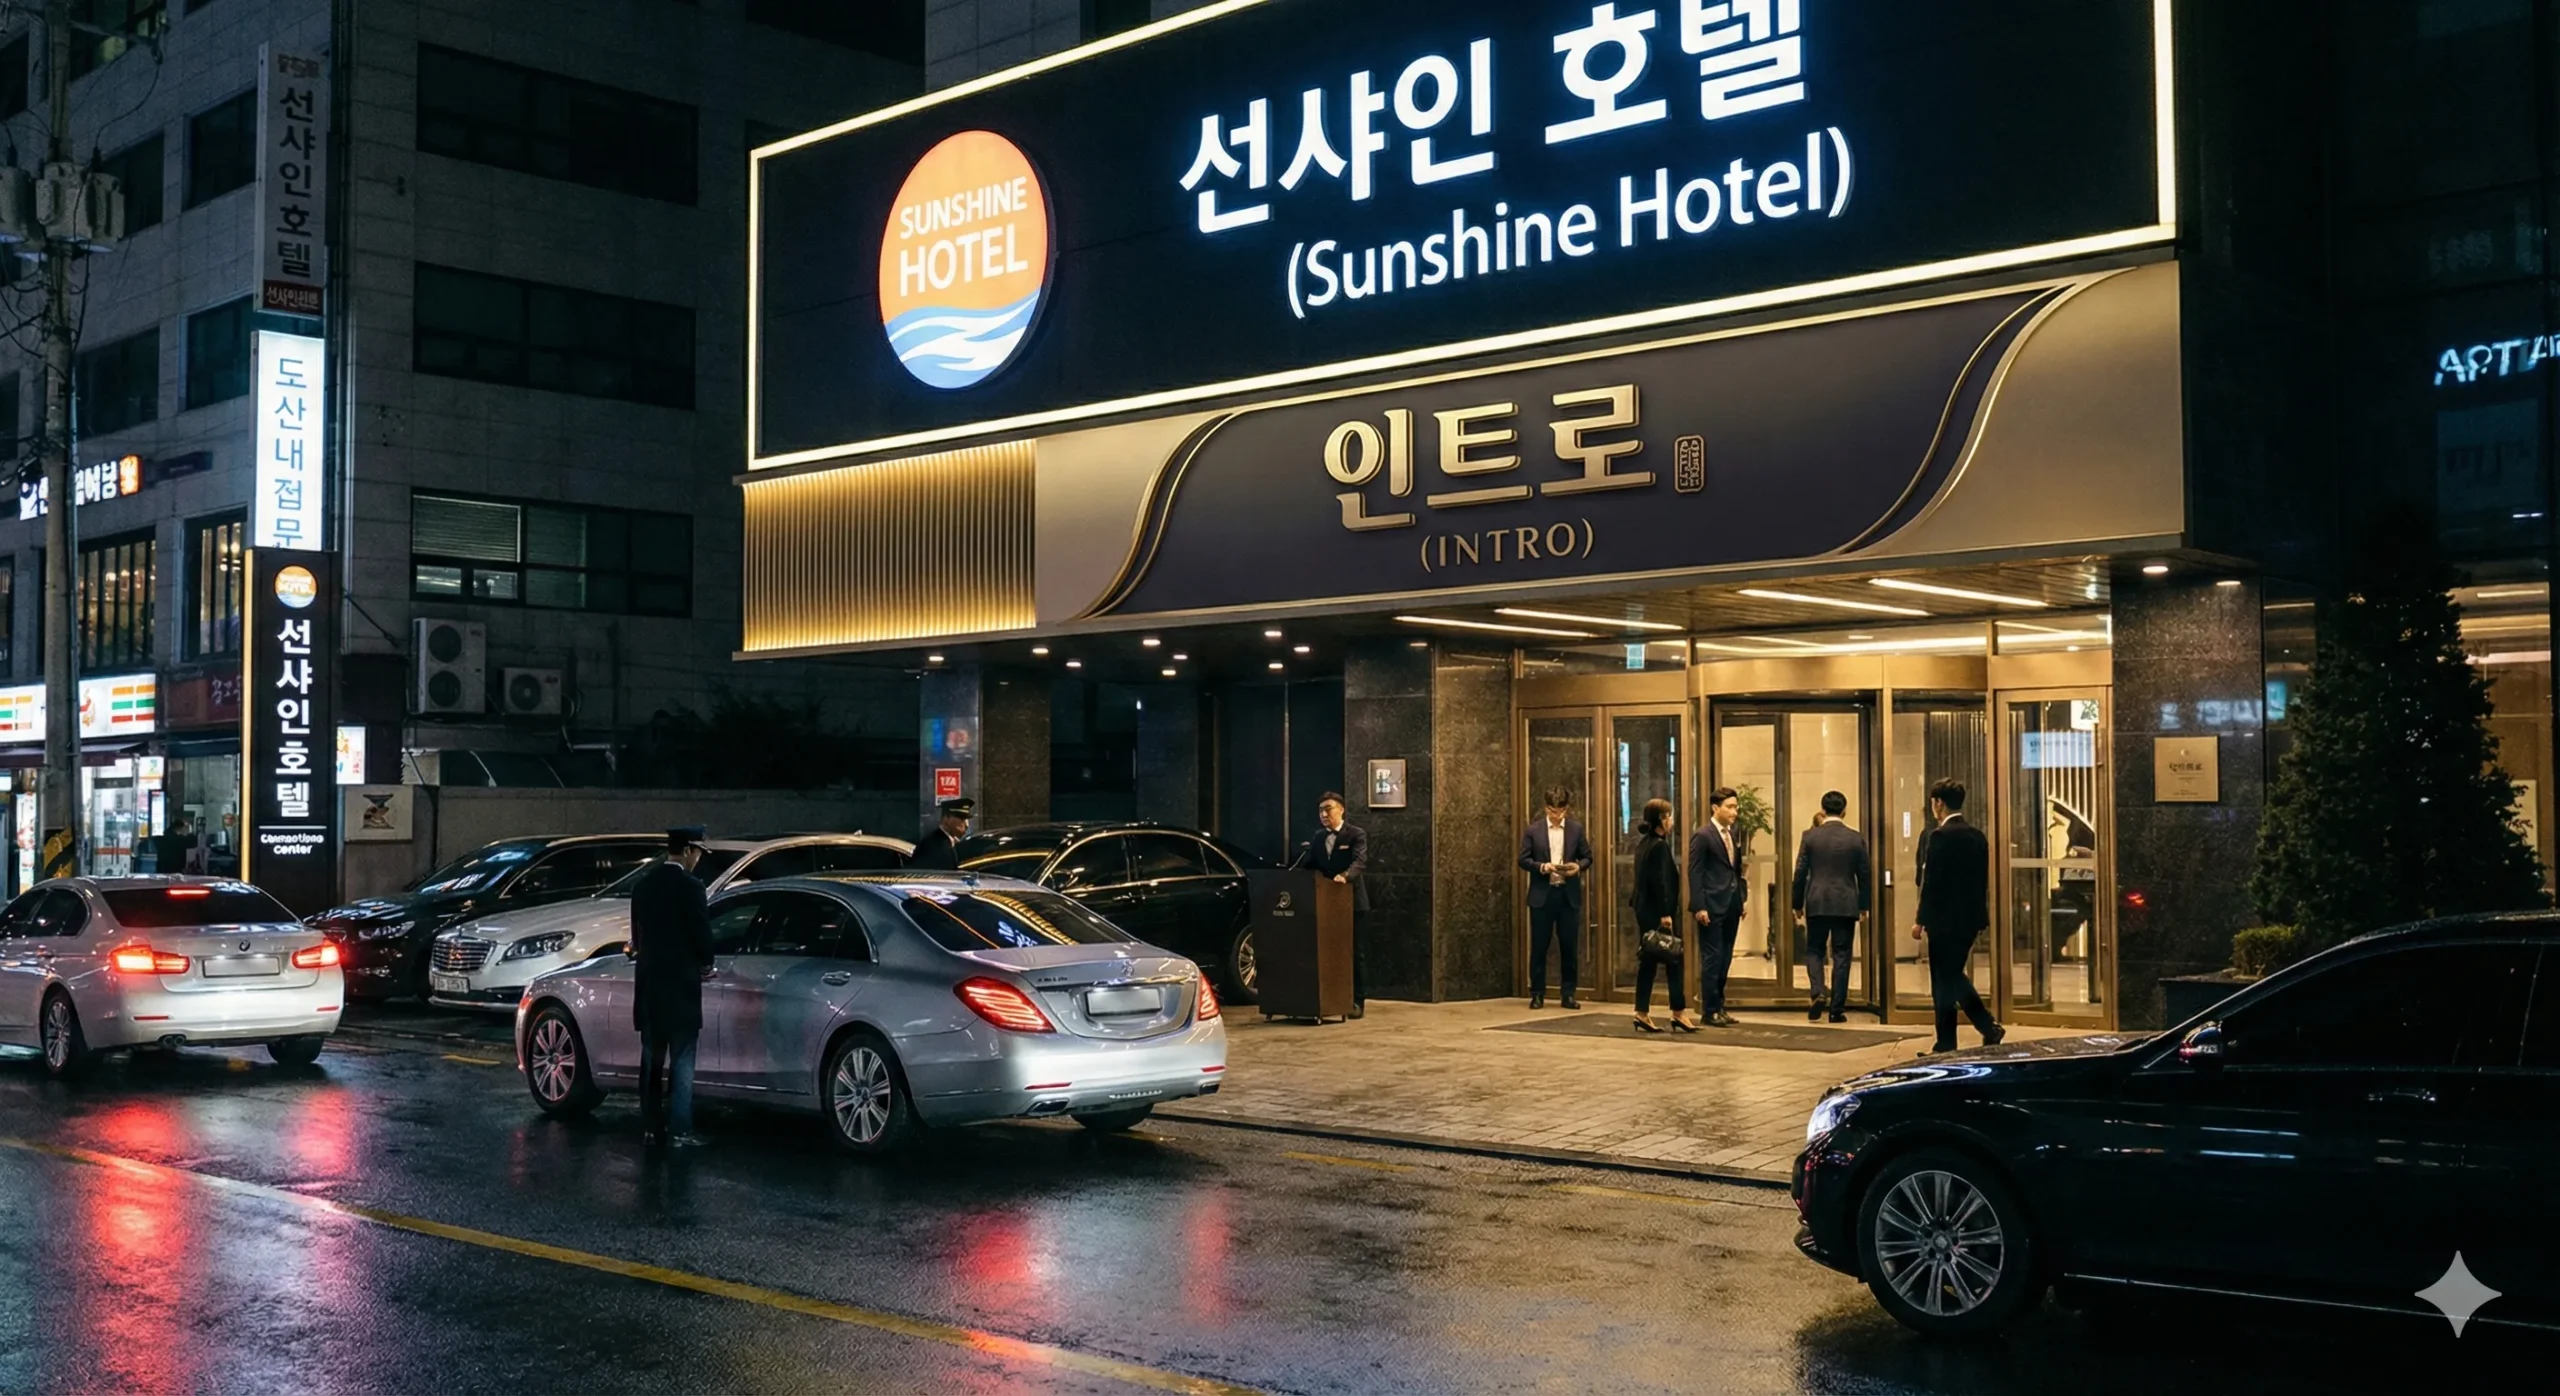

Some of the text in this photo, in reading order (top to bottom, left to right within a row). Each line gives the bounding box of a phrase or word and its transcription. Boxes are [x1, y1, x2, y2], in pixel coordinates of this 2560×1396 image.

[276, 86, 317, 279] 선샤인호텔
[1180, 0, 1807, 234] 선샤인 호텔
[899, 175, 1028, 241] SUNSHINE
[899, 222, 1029, 298] HOTEL
[1287, 126, 1852, 319] (Sunshine Hotel)
[1323, 383, 1657, 531] 인트로
[1420, 517, 1595, 573] (INTRO)
[276, 617, 313, 818] 선샤인호텔
